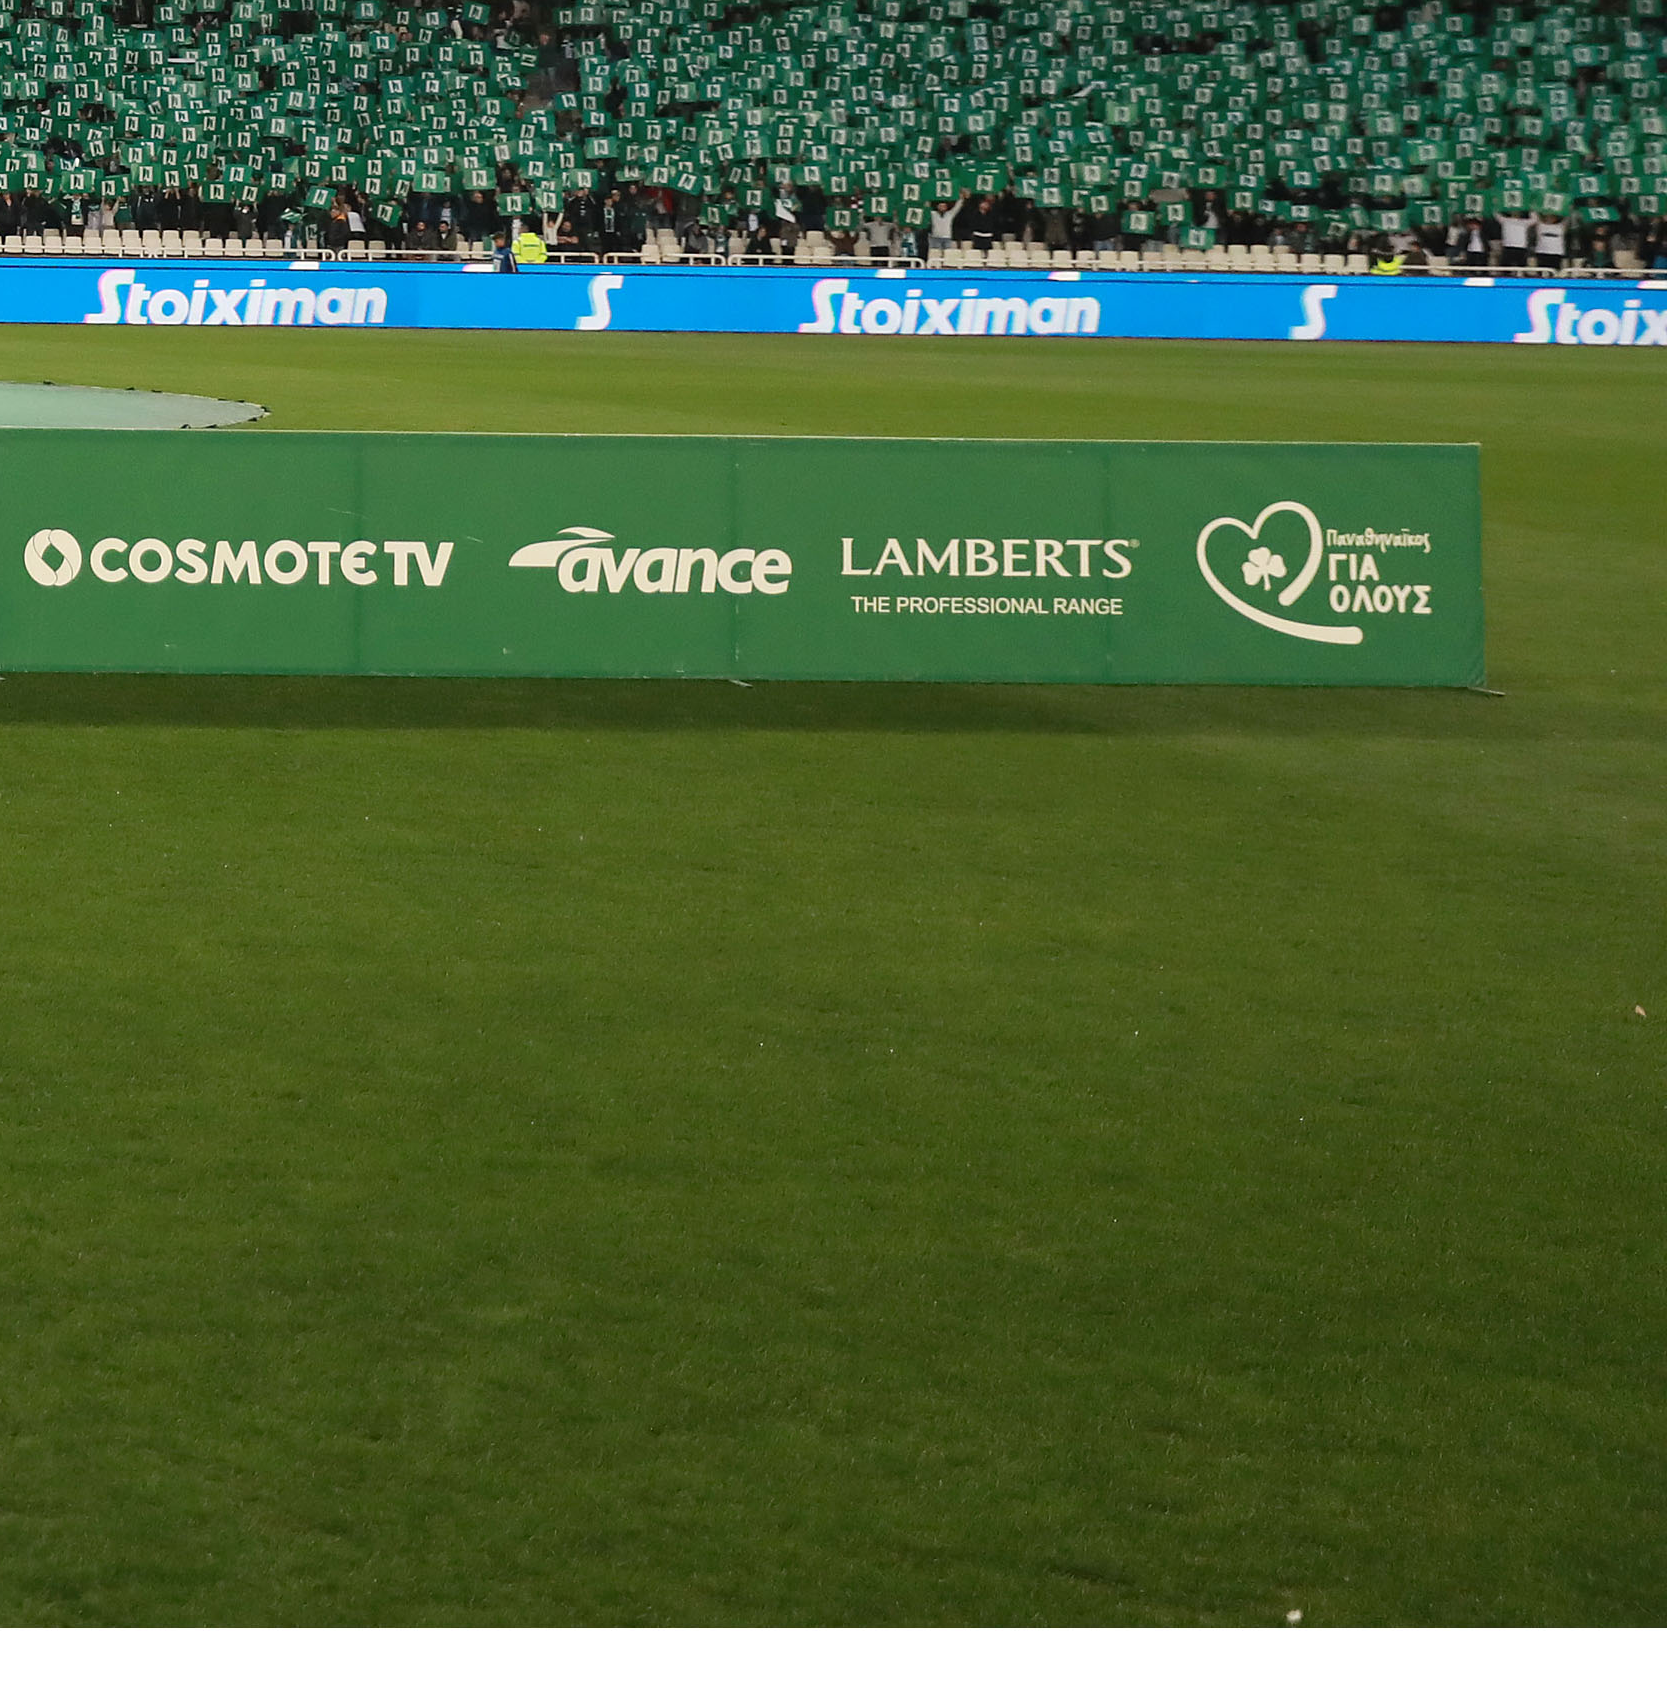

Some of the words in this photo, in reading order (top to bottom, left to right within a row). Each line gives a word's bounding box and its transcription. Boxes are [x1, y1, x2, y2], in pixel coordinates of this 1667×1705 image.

[84, 269, 387, 326] Stoiximan
[798, 279, 1099, 335] Stoiximan
[555, 542, 793, 595] avance
[1328, 553, 1380, 582] ΓΙΑ
[851, 595, 890, 613] THE
[896, 596, 1050, 614] PROFESSIONAL
[1053, 597, 1124, 615] RANGE
[1329, 584, 1432, 615] ΟΛΟΥΣ
